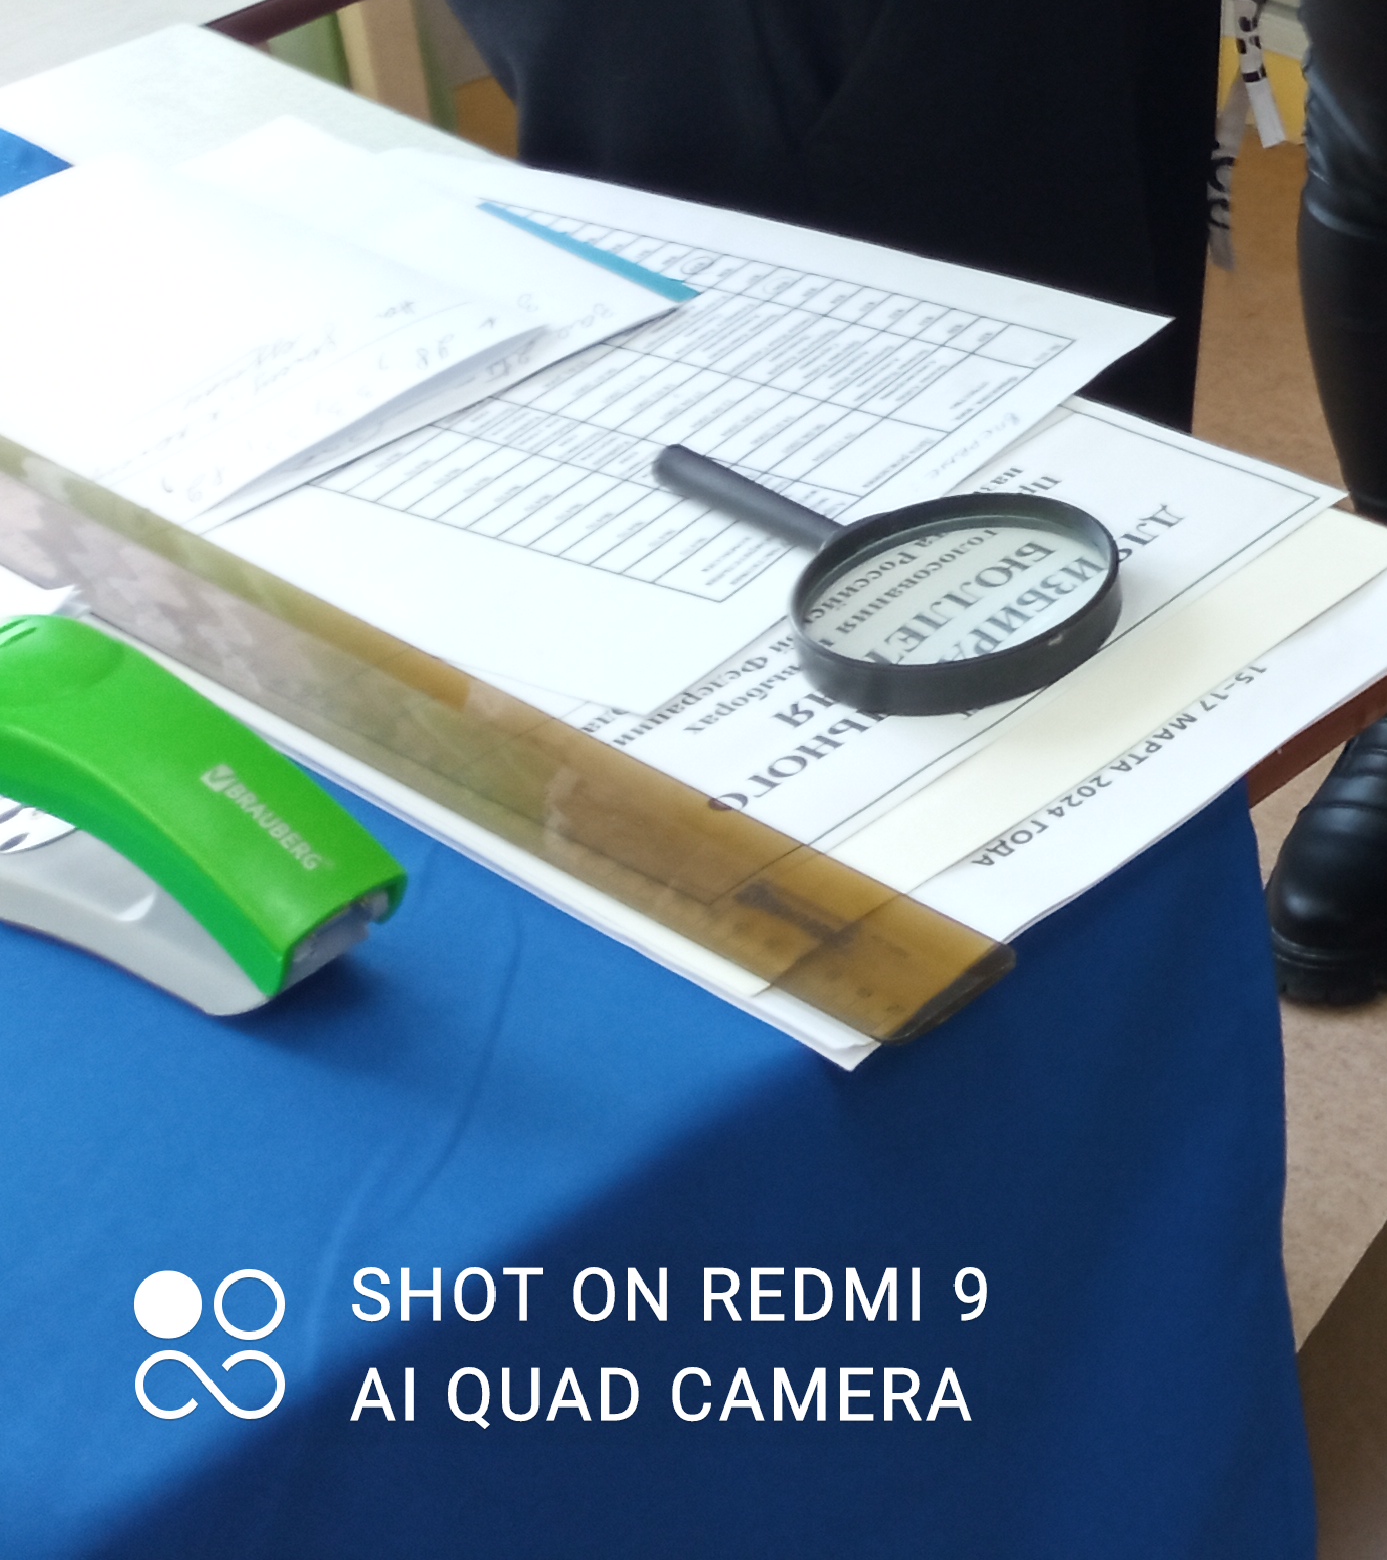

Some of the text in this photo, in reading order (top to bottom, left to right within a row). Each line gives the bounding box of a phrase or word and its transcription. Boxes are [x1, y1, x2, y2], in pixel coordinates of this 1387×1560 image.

[1109, 712, 1198, 773] МАРТА
[1047, 775, 1113, 818] 2024
[224, 783, 321, 870] BRAUBERG
[971, 819, 1049, 867] ГОДА
